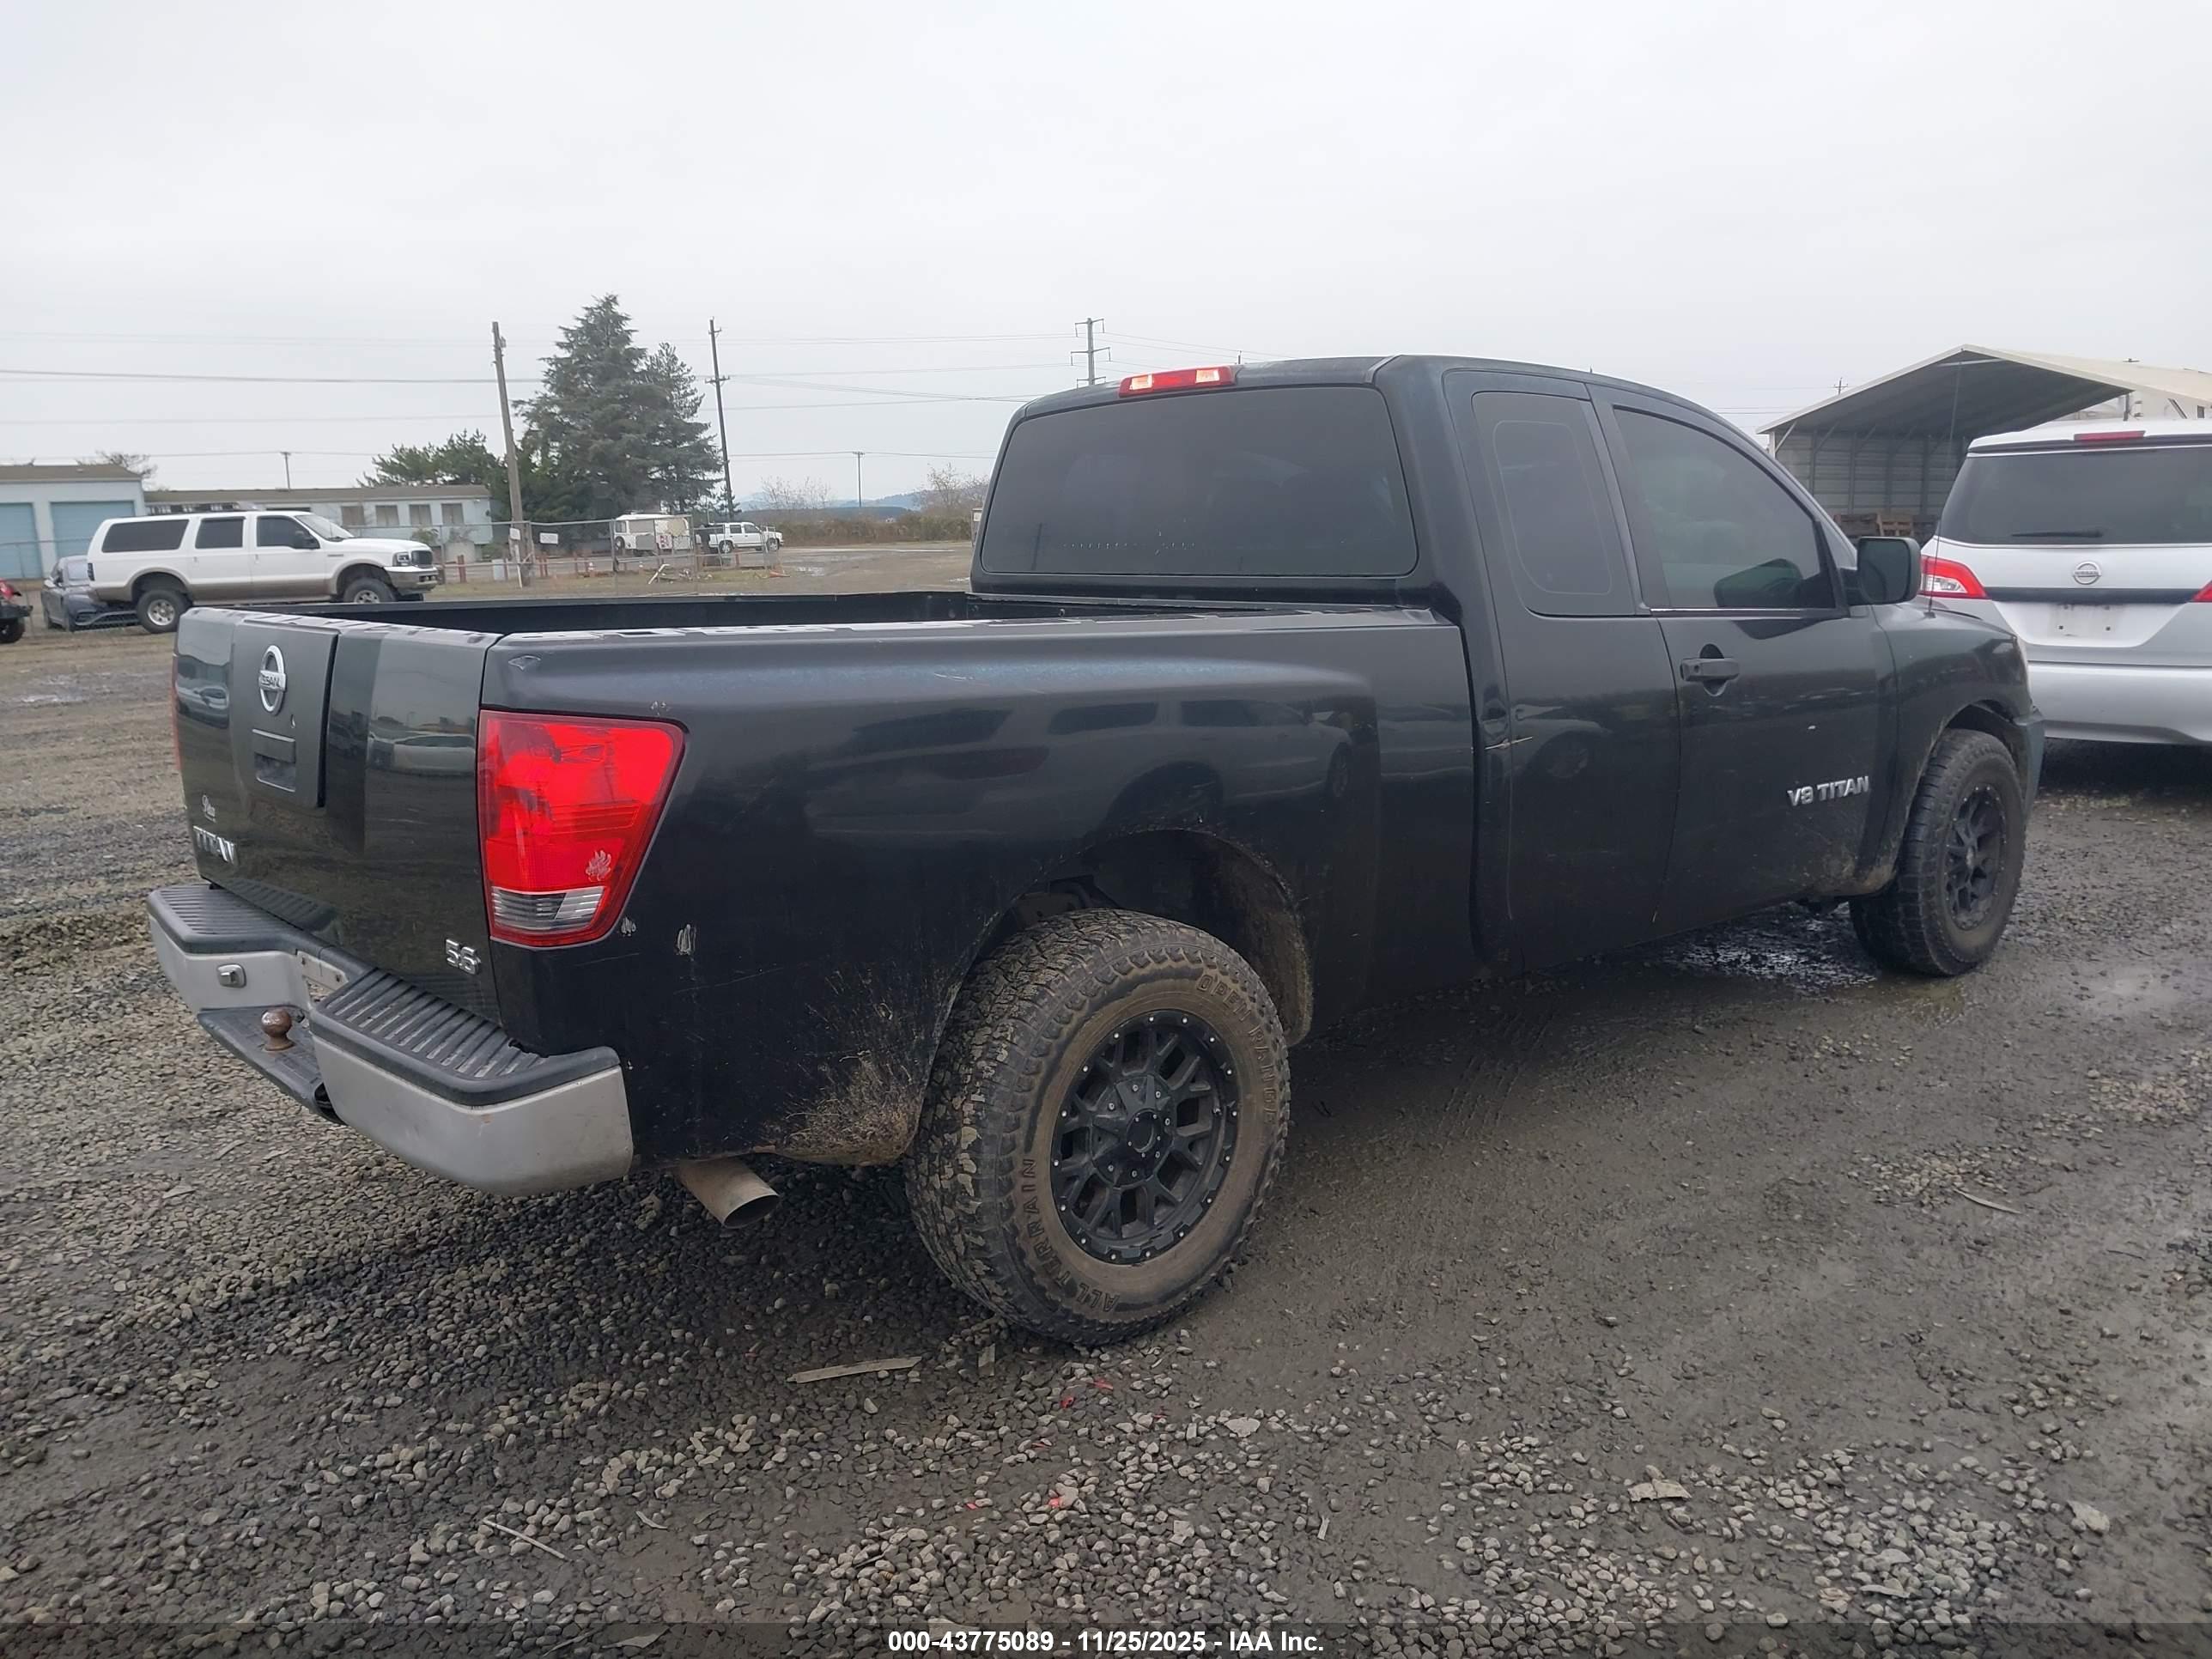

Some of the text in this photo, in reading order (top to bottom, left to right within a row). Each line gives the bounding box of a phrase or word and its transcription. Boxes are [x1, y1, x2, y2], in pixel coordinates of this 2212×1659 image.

[1787, 775, 1869, 806] V8 TITAN
[192, 824, 234, 865] TITAN
[1196, 974, 1252, 1022] OPEN
[1076, 1282, 1121, 1313] ALL
